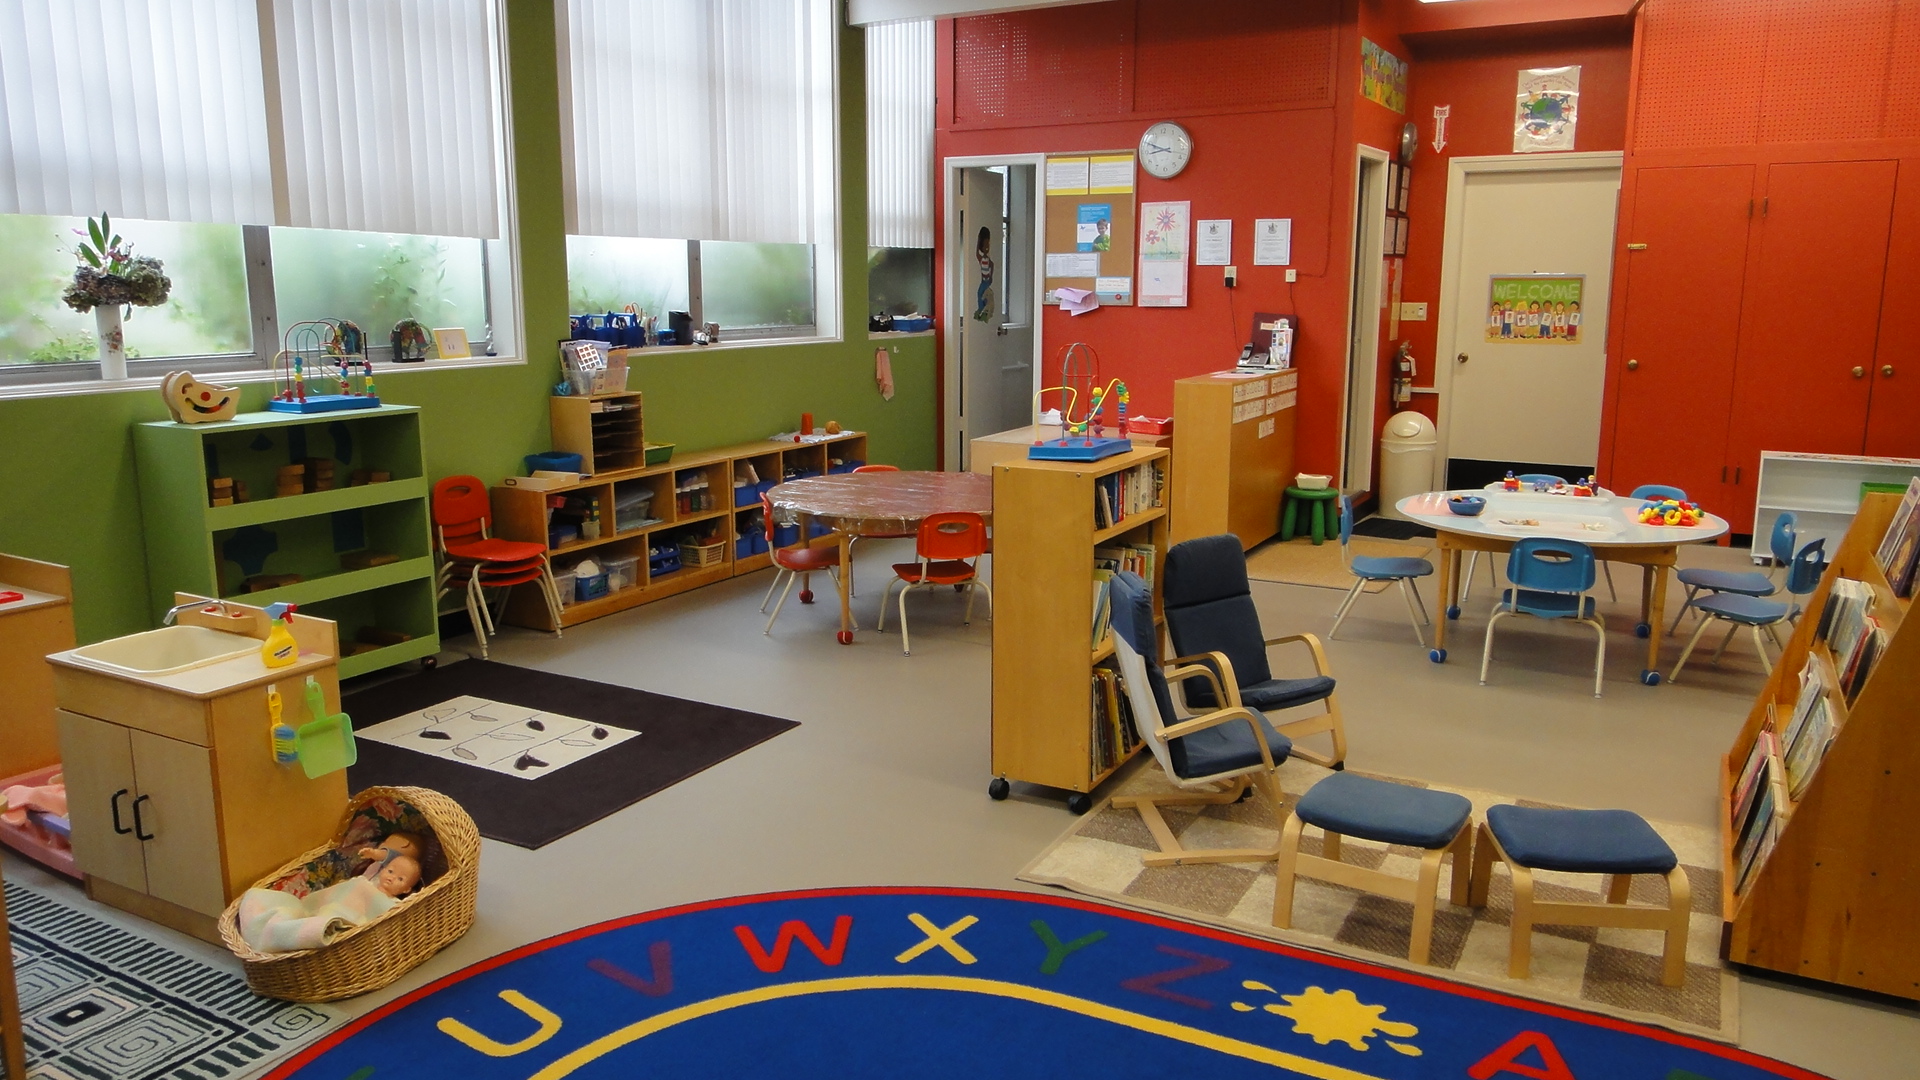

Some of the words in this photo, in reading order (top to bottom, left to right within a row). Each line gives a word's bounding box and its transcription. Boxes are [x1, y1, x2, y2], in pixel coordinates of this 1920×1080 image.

[1493, 283, 1580, 300] WELCOME
[437, 989, 563, 1057] U
[587, 941, 673, 997] V
[733, 915, 853, 973] W
[895, 912, 979, 965] X
[1029, 919, 1108, 975] Y
[1120, 944, 1232, 1010] Z
[1467, 1030, 1576, 1080] A
